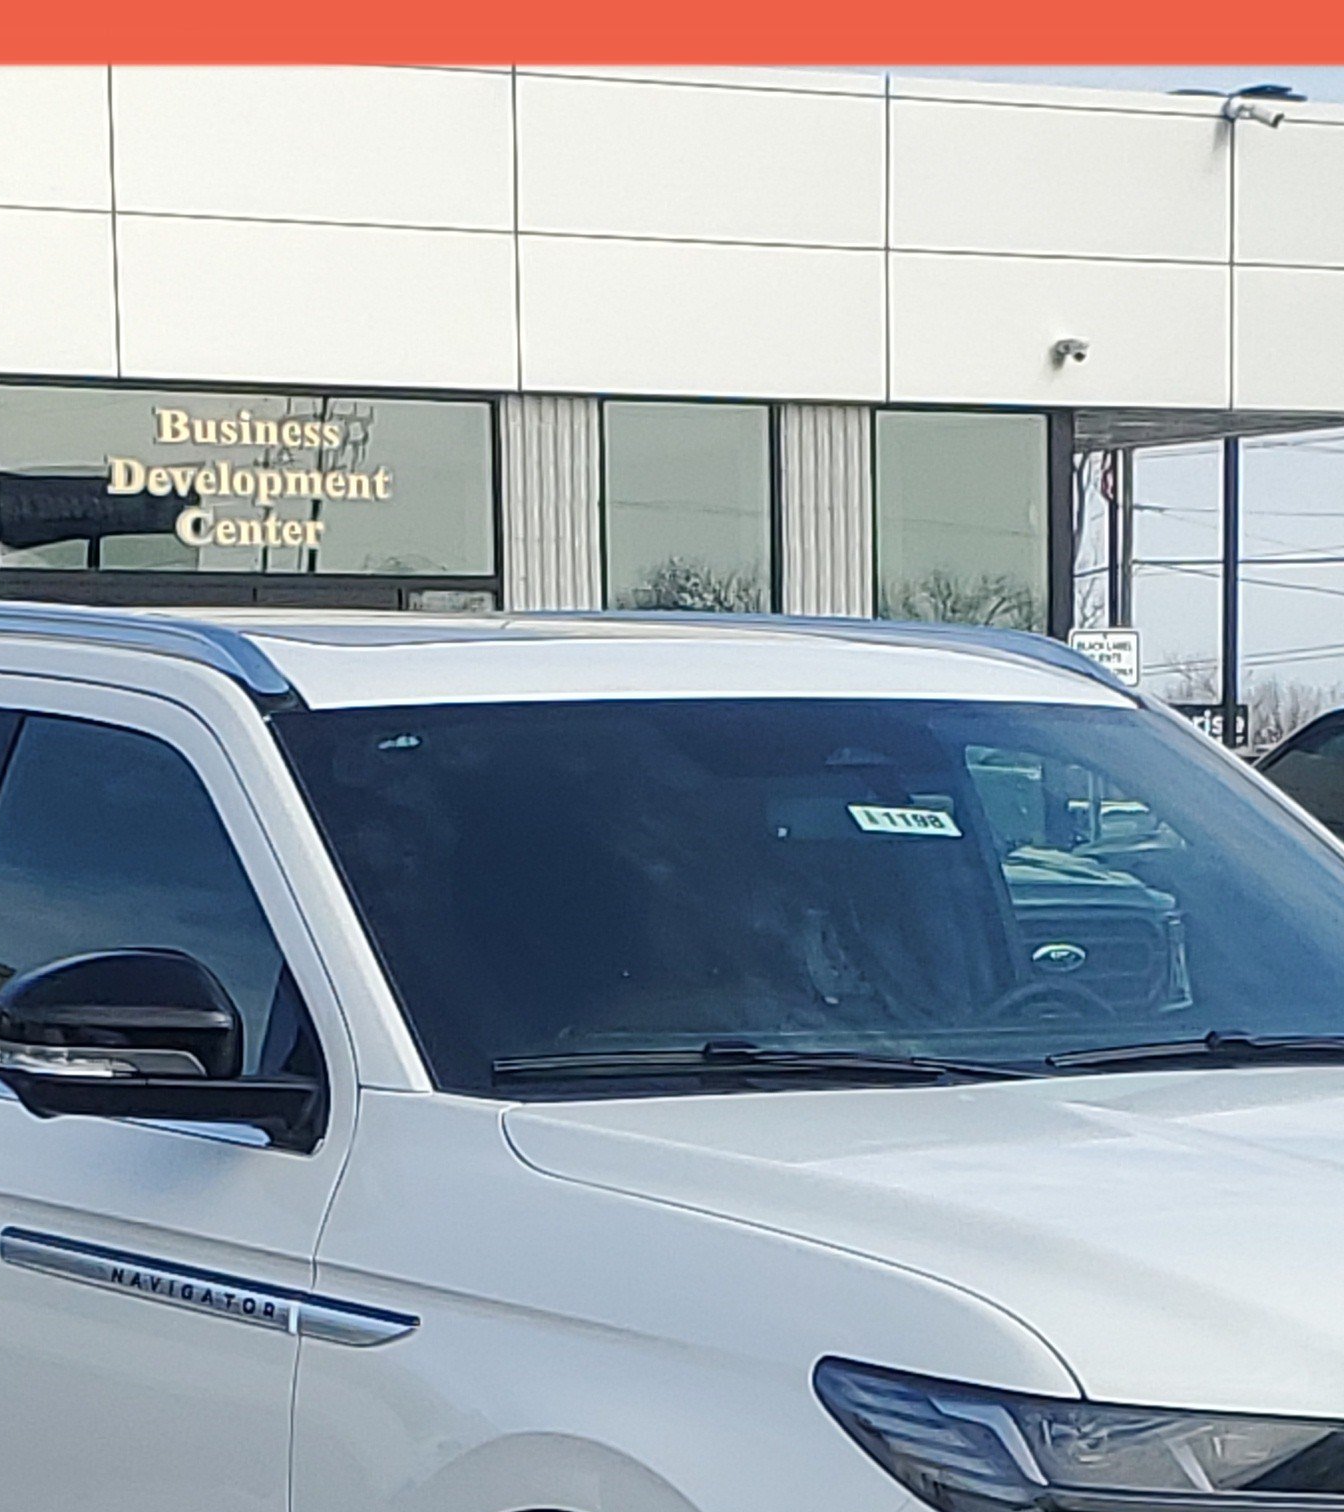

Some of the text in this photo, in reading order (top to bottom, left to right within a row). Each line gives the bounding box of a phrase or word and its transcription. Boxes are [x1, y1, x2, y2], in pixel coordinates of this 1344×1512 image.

[155, 408, 342, 447] Business
[107, 456, 391, 506] Development
[175, 506, 324, 547] Center
[109, 1266, 276, 1319] NAVIGATOR
